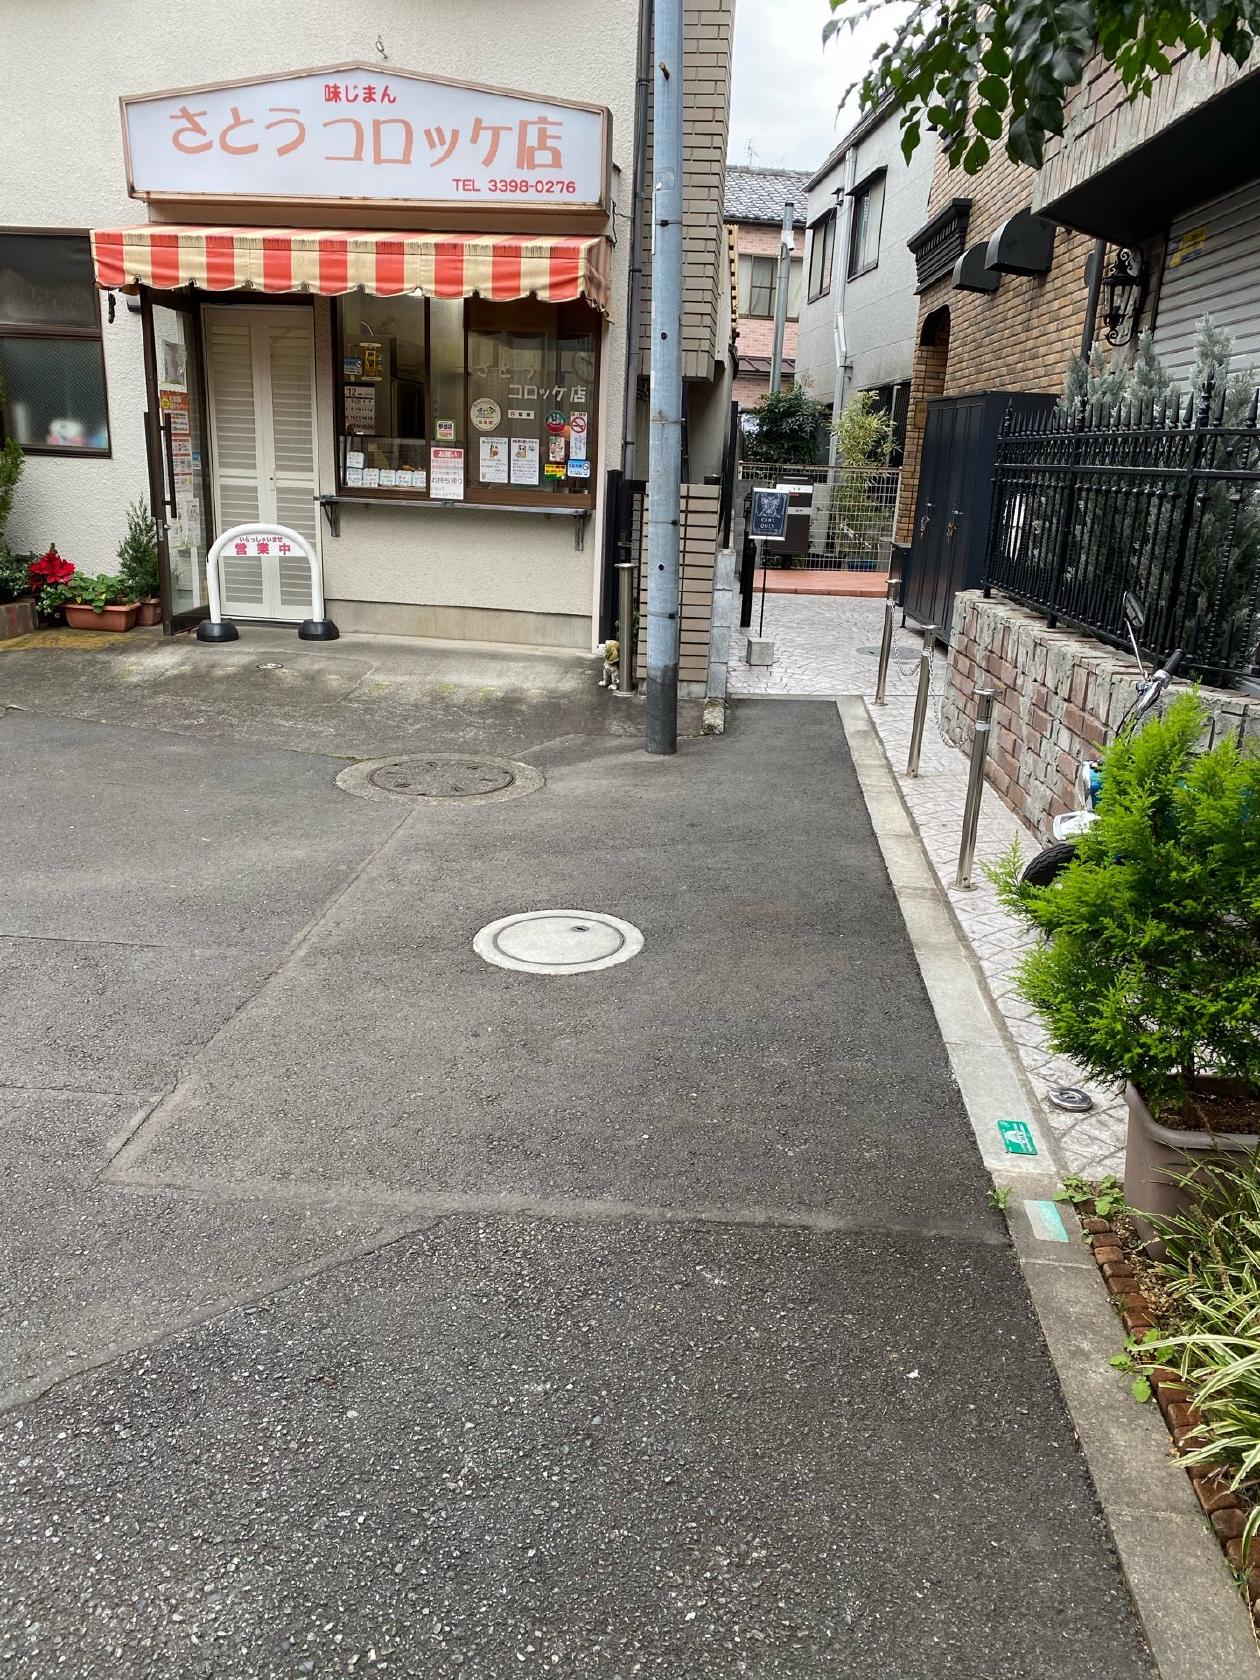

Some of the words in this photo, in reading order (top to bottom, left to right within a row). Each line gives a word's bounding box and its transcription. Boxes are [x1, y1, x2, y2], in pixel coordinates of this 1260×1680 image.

[324, 83, 397, 104] 味じまん
[452, 178, 481, 193] TEL
[488, 179, 576, 194] 3398-0276
[508, 385, 587, 403] コロッケ店
[234, 542, 291, 556] 営業中
